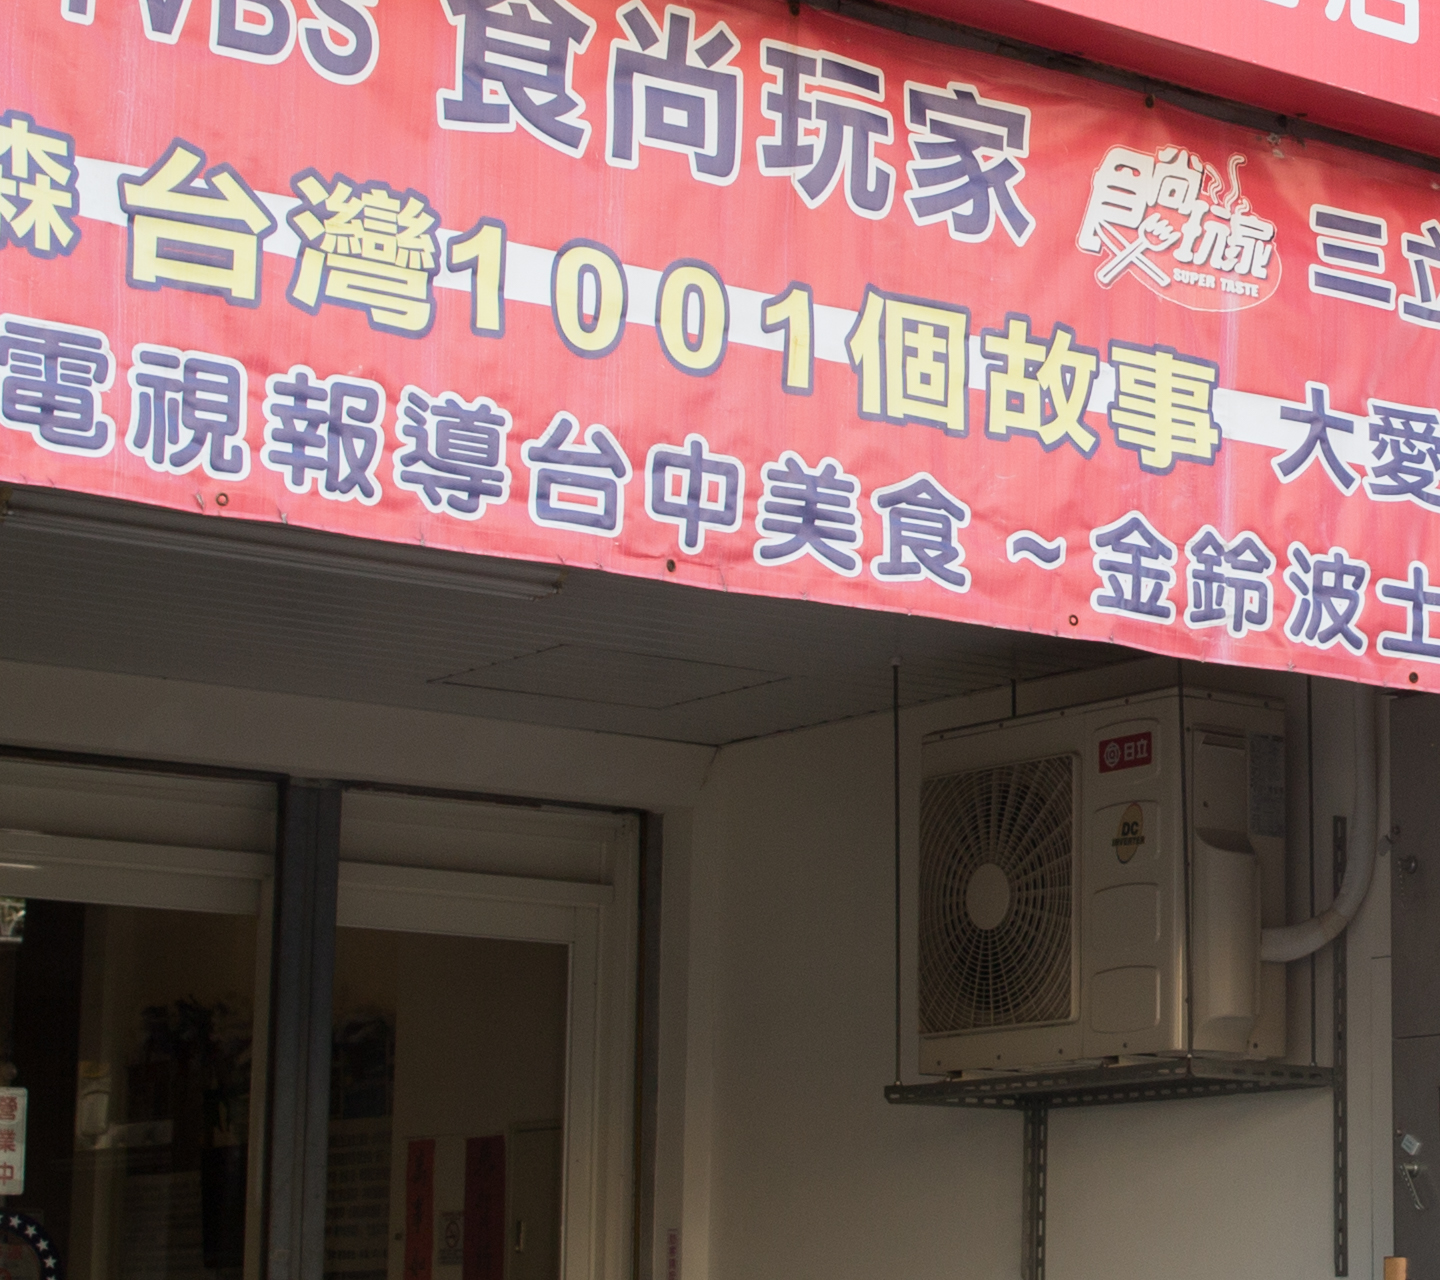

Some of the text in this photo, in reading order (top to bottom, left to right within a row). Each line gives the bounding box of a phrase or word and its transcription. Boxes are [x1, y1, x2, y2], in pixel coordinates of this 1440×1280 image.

[1173, 268, 1260, 298] SUPER TASTE
[120, 140, 1221, 472] 台灣1001個故事
[1123, 738, 1149, 761] 日立
[1121, 820, 1140, 838] DC
[1111, 835, 1146, 848] INVERTER
